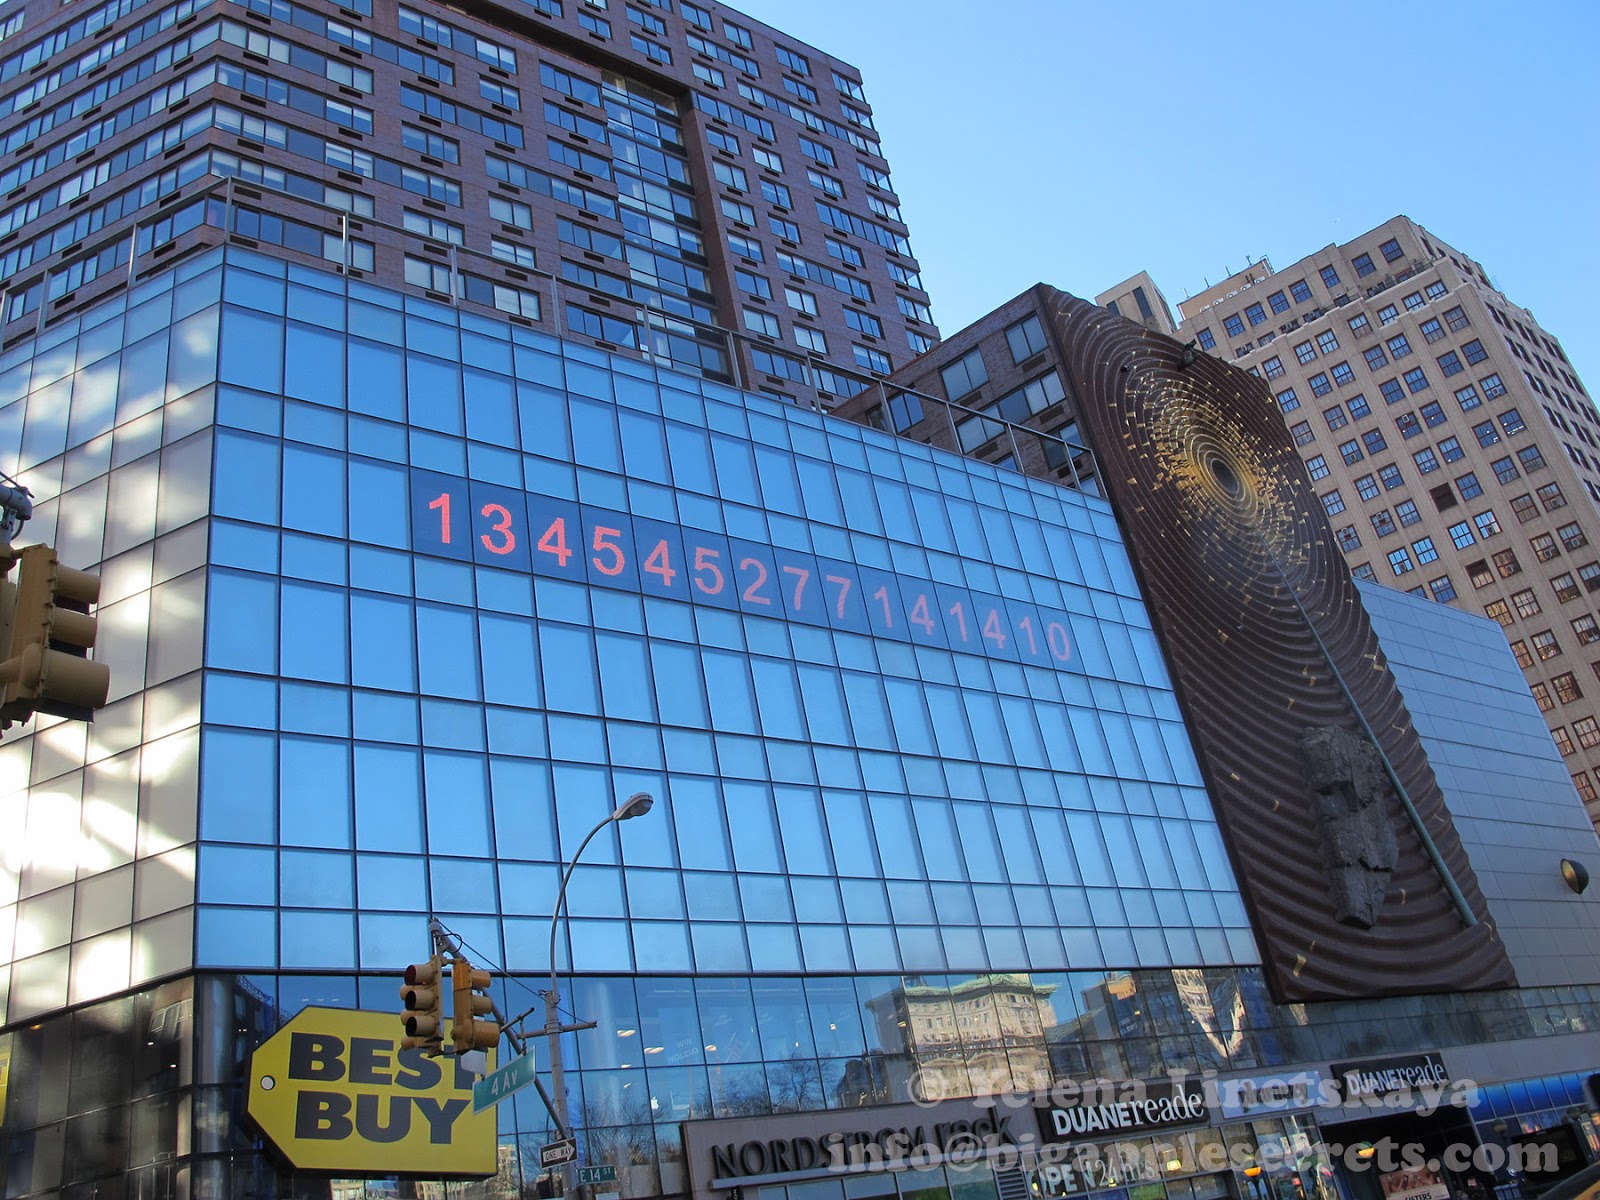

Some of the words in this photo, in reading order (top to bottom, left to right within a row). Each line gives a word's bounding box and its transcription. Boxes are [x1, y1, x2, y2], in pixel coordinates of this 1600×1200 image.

[288, 1032, 488, 1090] BEST
[491, 1077, 499, 1096] 4
[295, 1090, 472, 1144] BUY
[545, 1149, 557, 1161] ONE
[560, 1145, 573, 1158] WAY
[710, 1125, 928, 1181] NORDSTROM
[934, 1106, 1021, 1154] rack
[580, 1172, 587, 1182] E
[589, 1170, 601, 1182] 14
[1026, 1161, 1096, 1197] OPEN
[1095, 1158, 1120, 1187] 24
